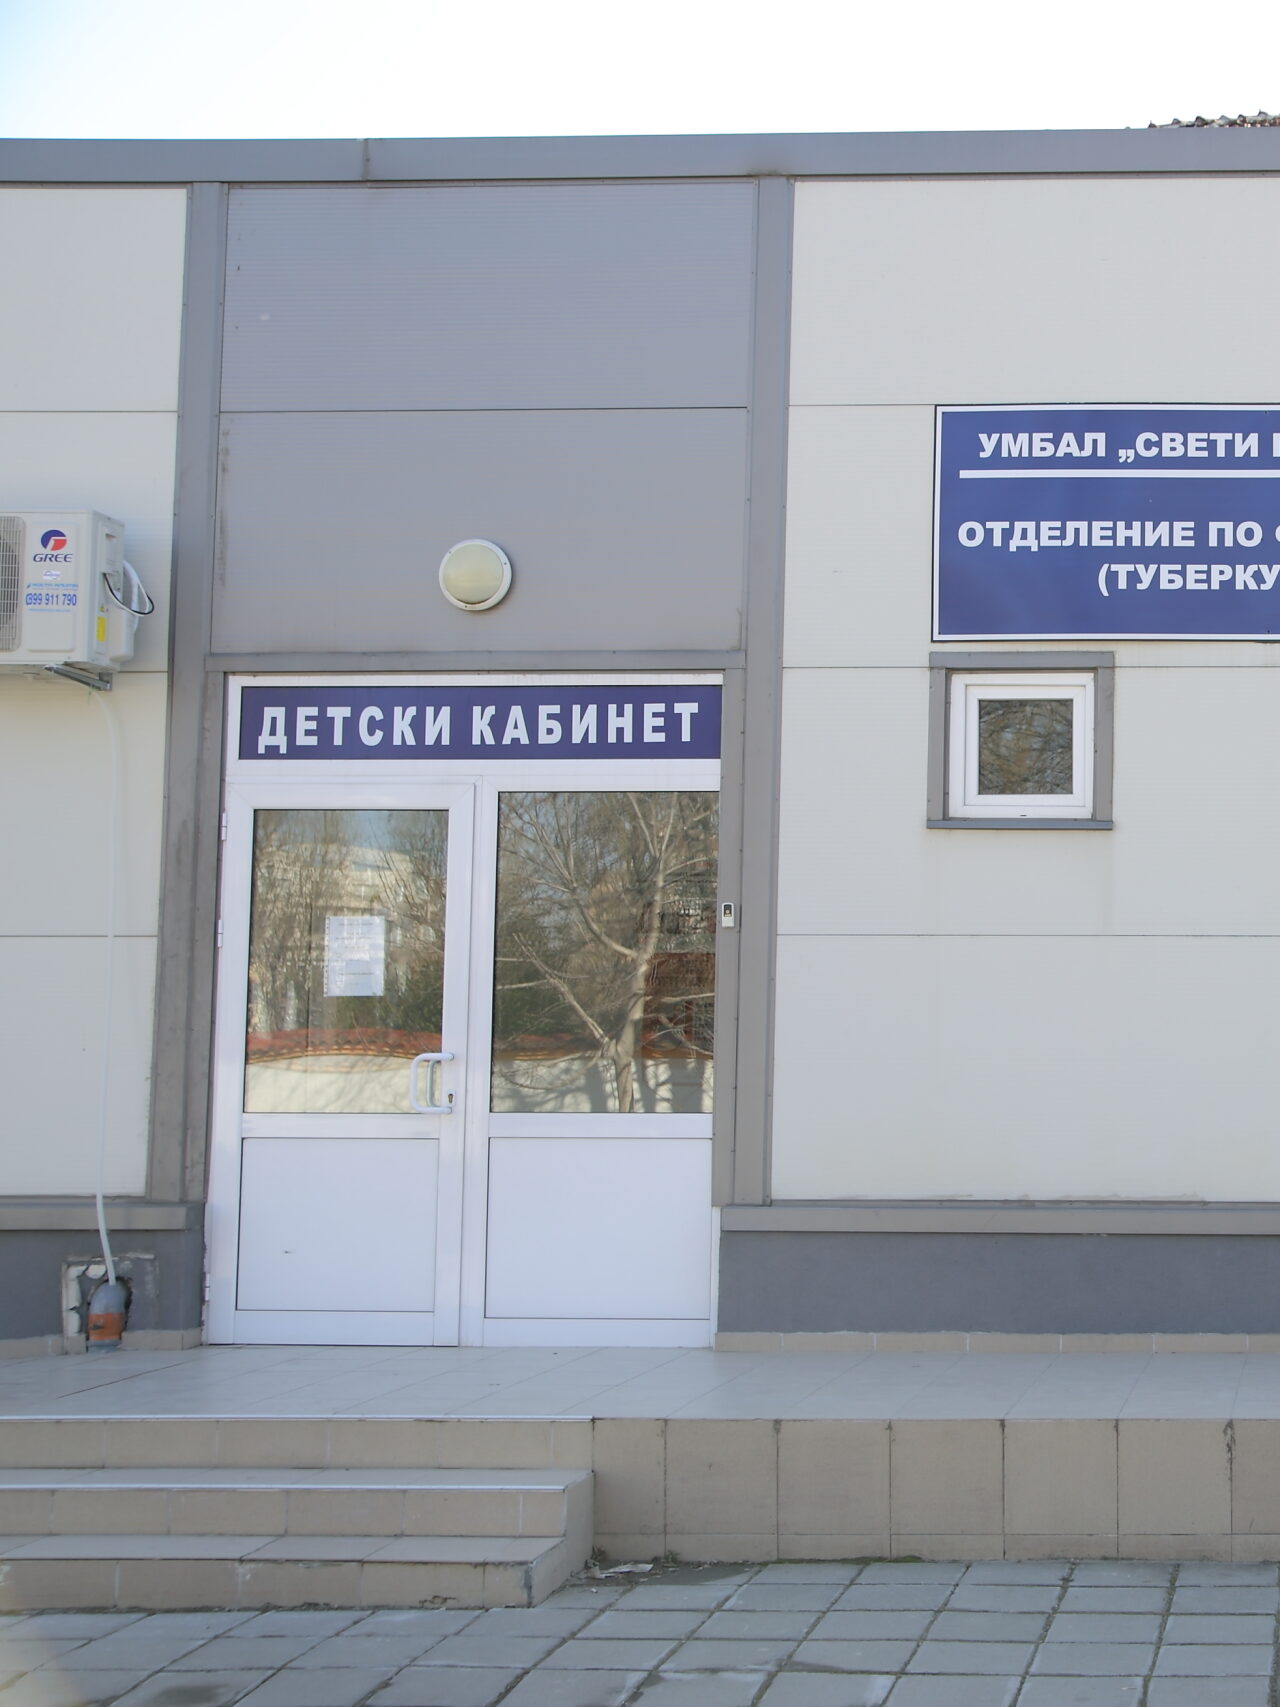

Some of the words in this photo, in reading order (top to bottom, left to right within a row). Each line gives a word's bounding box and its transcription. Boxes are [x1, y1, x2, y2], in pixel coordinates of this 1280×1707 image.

[979, 432, 1106, 458] УМБАЛ
[958, 520, 1195, 552] ОТДЕЛЕНИЕ
[1208, 520, 1263, 548] ПО
[33, 553, 73, 563] GREE
[258, 705, 451, 754] ДЕТСКИ
[471, 702, 699, 745] КАБИНЕТ
